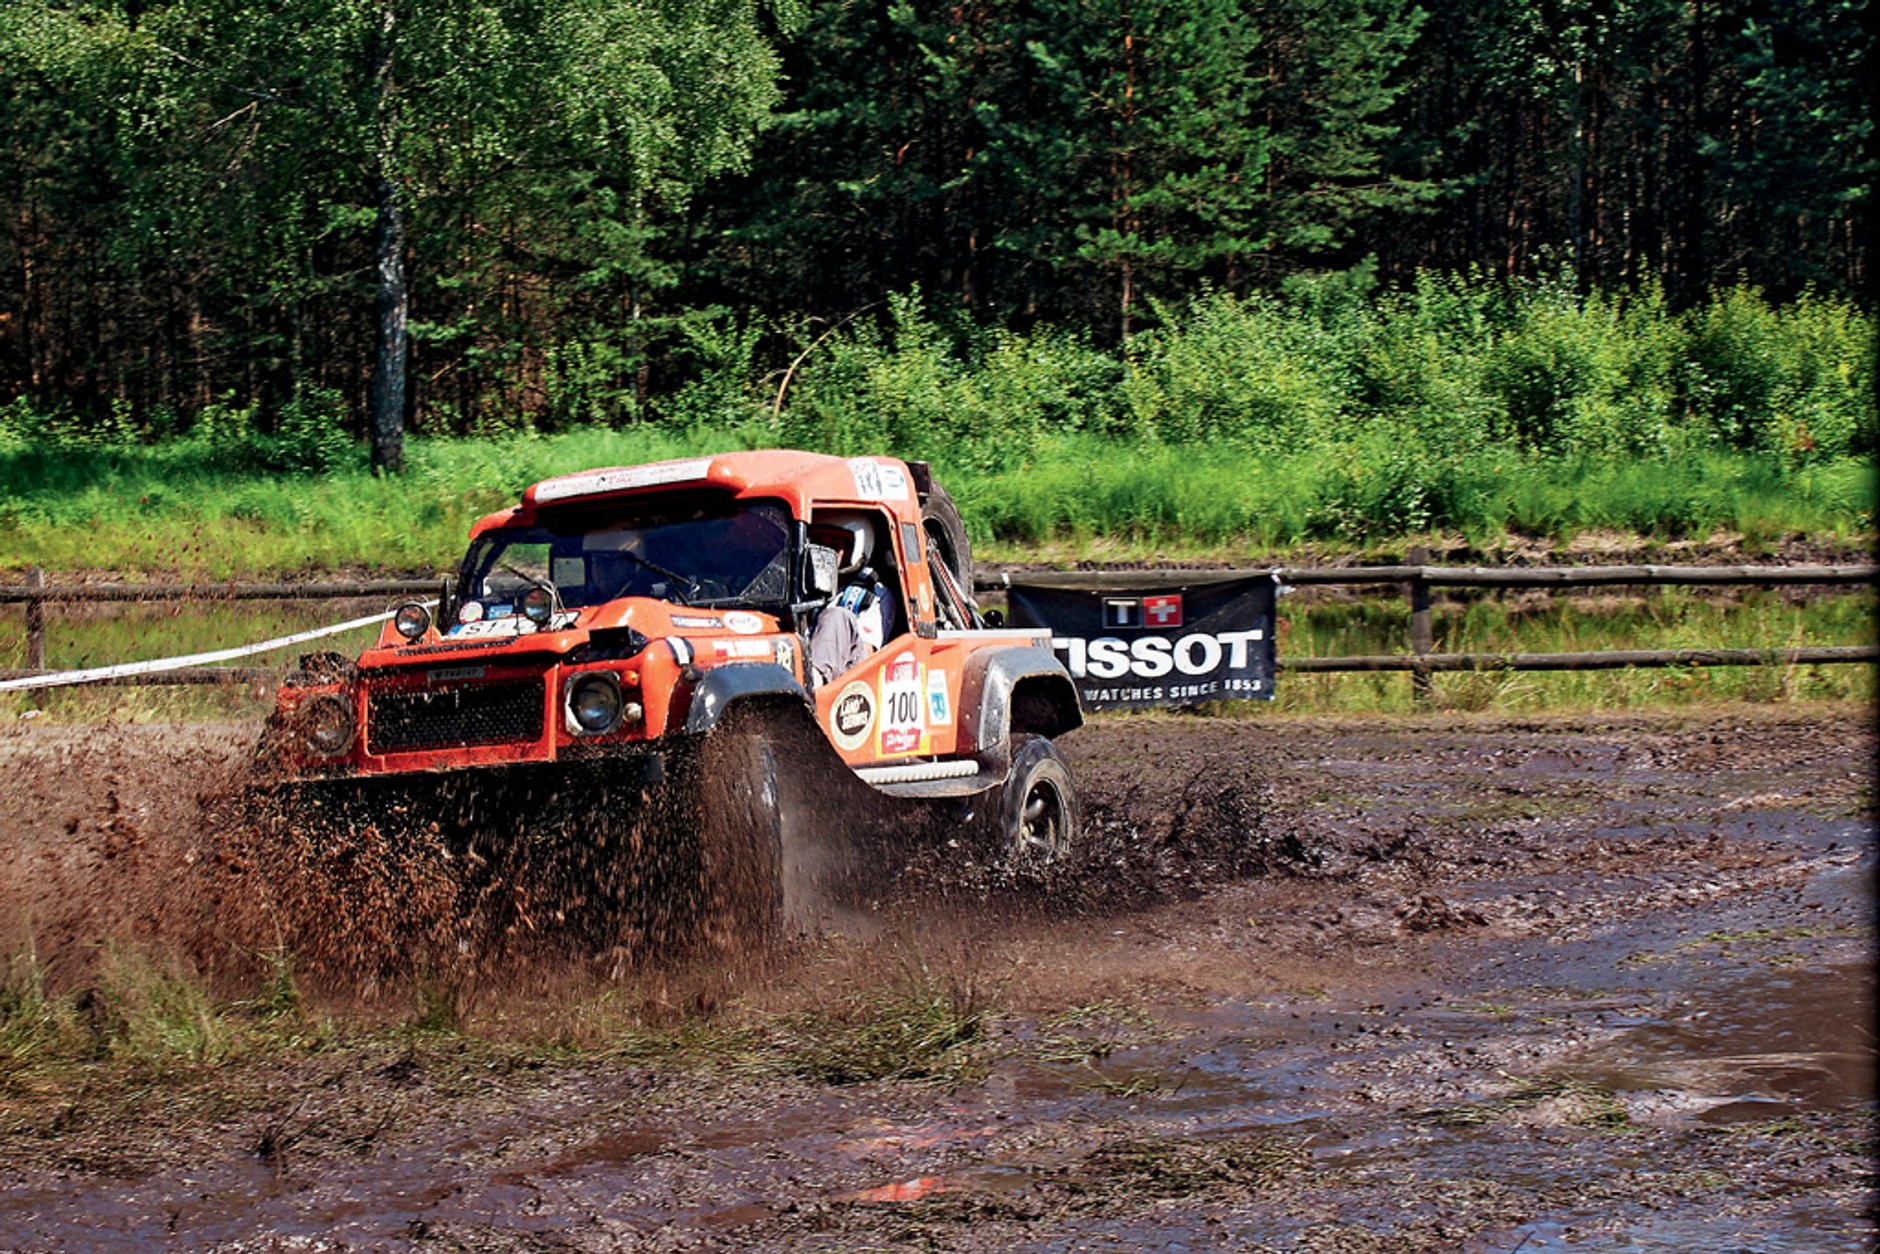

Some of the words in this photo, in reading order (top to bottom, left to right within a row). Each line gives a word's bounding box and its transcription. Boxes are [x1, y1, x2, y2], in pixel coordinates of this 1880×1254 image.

[1052, 629, 1263, 679] ISSOT
[888, 690, 919, 725] 100
[1083, 688, 1163, 702] WATCHES
[1169, 683, 1219, 699] SINCE
[1224, 679, 1262, 692] 1853
